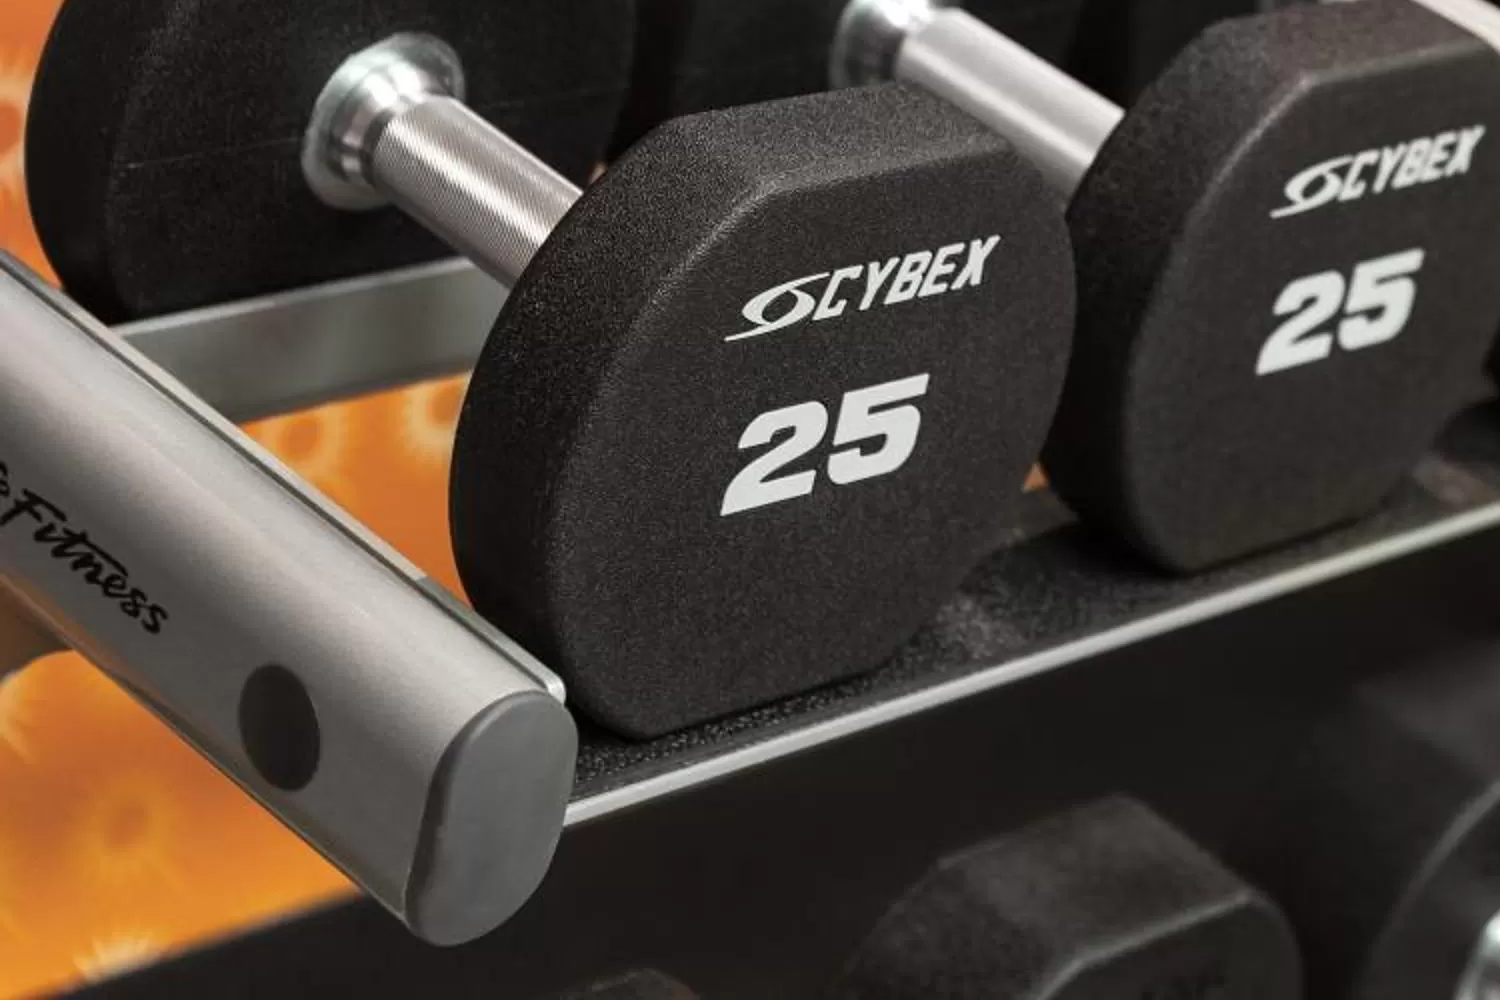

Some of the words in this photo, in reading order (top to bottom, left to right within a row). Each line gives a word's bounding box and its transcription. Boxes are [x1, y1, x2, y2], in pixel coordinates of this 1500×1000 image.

[1336, 124, 1486, 203] CYBEX
[811, 234, 1001, 321] CYBEX
[1255, 248, 1425, 376] 25
[720, 372, 931, 517] 25
